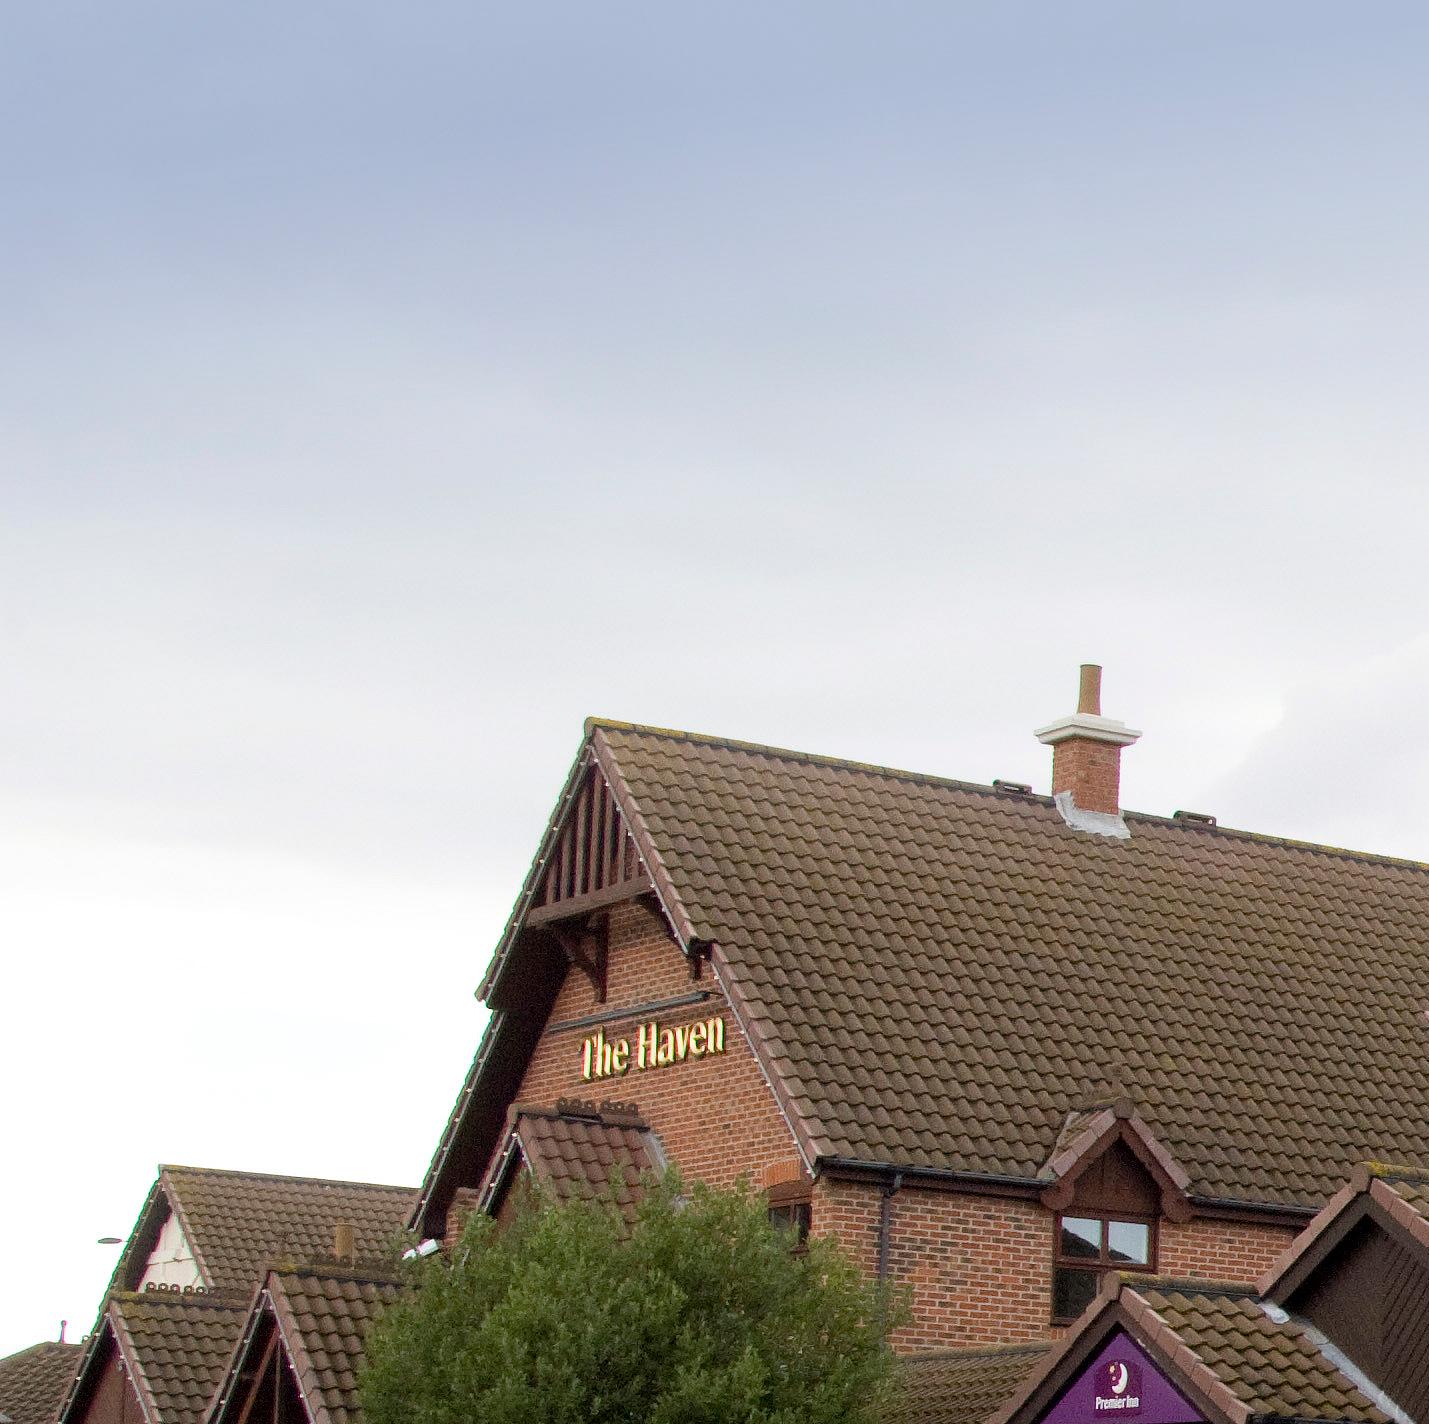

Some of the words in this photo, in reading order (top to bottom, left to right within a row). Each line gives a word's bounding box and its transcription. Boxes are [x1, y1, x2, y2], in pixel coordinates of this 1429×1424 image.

[579, 1025, 630, 1080] The
[637, 1016, 725, 1069] Haven
[1095, 1395, 1126, 1410] Premier
[1126, 1395, 1140, 1408] Inn
